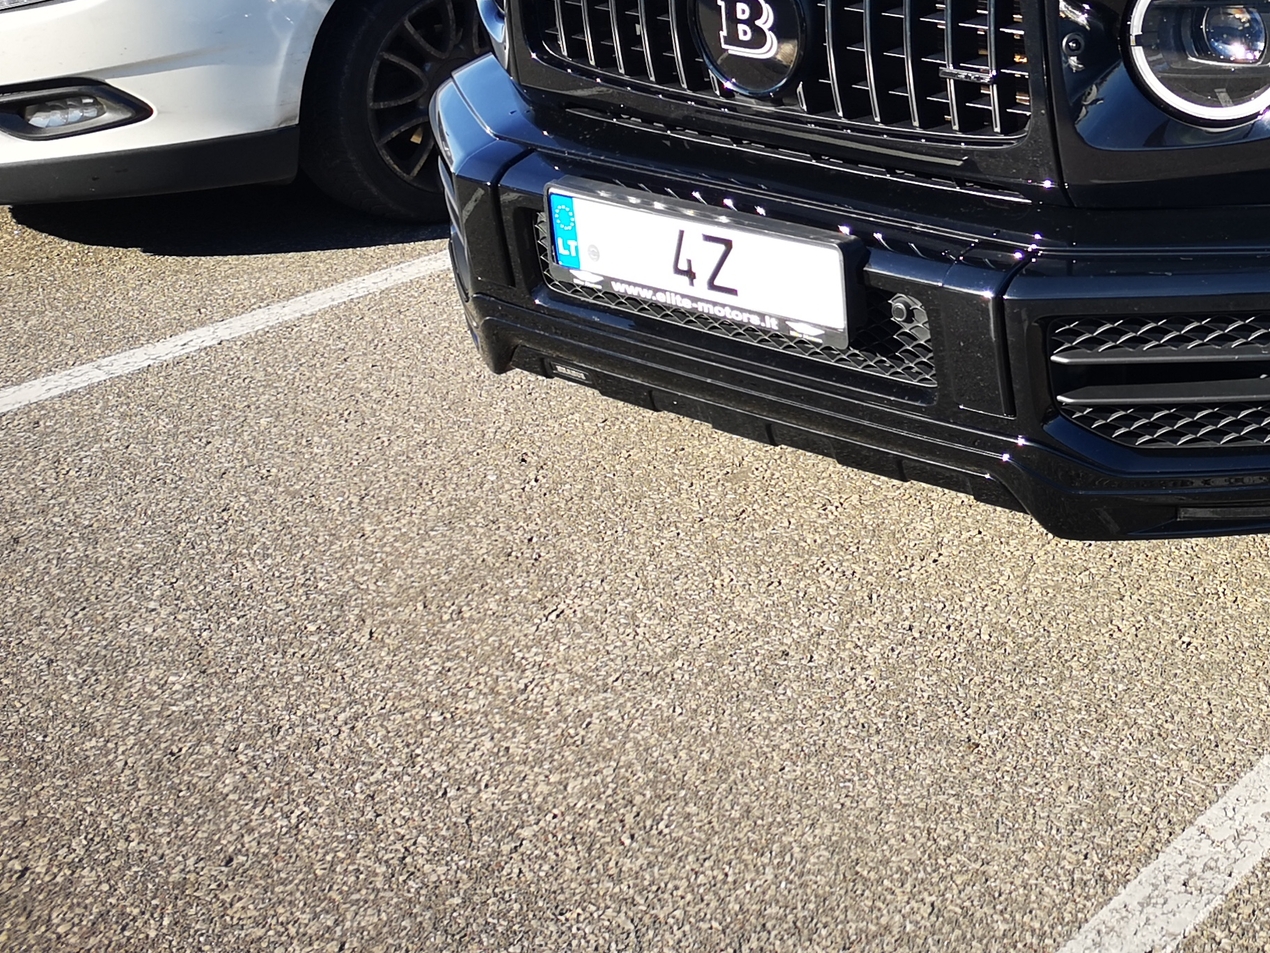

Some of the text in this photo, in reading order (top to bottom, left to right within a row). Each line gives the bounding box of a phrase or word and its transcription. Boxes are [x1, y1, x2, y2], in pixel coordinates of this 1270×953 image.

[557, 237, 578, 256] LT
[673, 229, 739, 297] 4Z
[610, 280, 779, 331] www.elite-motors.lt
